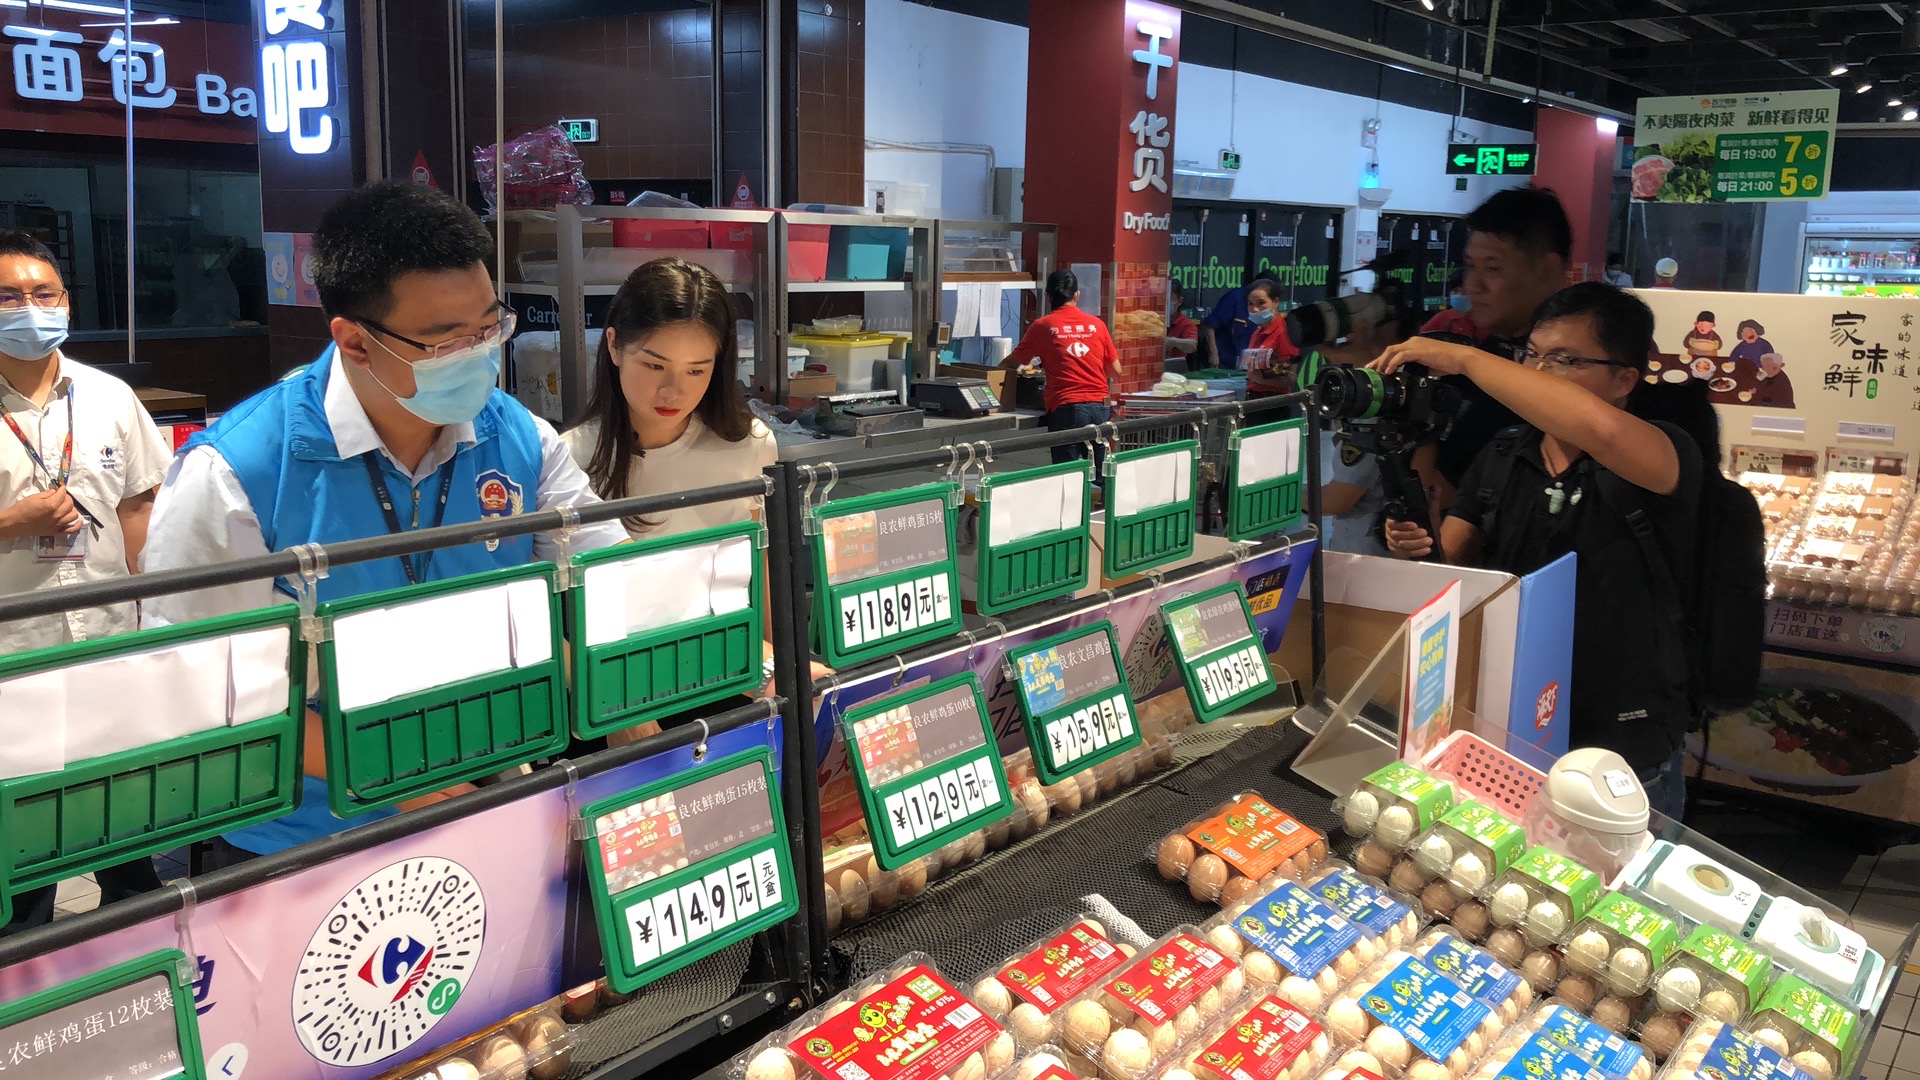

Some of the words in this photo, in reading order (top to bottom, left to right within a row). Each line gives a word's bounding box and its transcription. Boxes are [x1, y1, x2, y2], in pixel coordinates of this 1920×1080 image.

[3, 25, 177, 109] 面包
[1130, 21, 1174, 194] 干货
[1643, 112, 1735, 129] 不卖隔夜肉菜
[1747, 108, 1830, 126] 新鲜看得见
[1719, 149, 1741, 161] 每日
[1744, 149, 1777, 160] 19:00
[1784, 135, 1803, 163] 7
[1807, 146, 1820, 158] 折
[1717, 181, 1738, 192] 每日
[1740, 181, 1773, 191] 21:00
[1780, 167, 1798, 196] 5
[1803, 176, 1816, 189] 折
[1050, 324, 1097, 335] 为您服务
[1892, 313, 1913, 378] 家的味道
[879, 510, 944, 536] 良农鲜鸡蛋15枚
[845, 587, 931, 632] ¥18.9元
[1773, 607, 1844, 627] 扫码下单
[1769, 621, 1839, 642] 门店直送
[1202, 657, 1255, 694] ¥19.5元
[1051, 707, 1116, 754] ¥15.9元
[678, 775, 768, 820] 良农鲜鸡蛋15枚装
[892, 773, 980, 830] ¥12.9元
[761, 861, 776, 898] 元/盒
[635, 872, 753, 944] ¥14.9元
[158, 1049, 178, 1064] 合格
